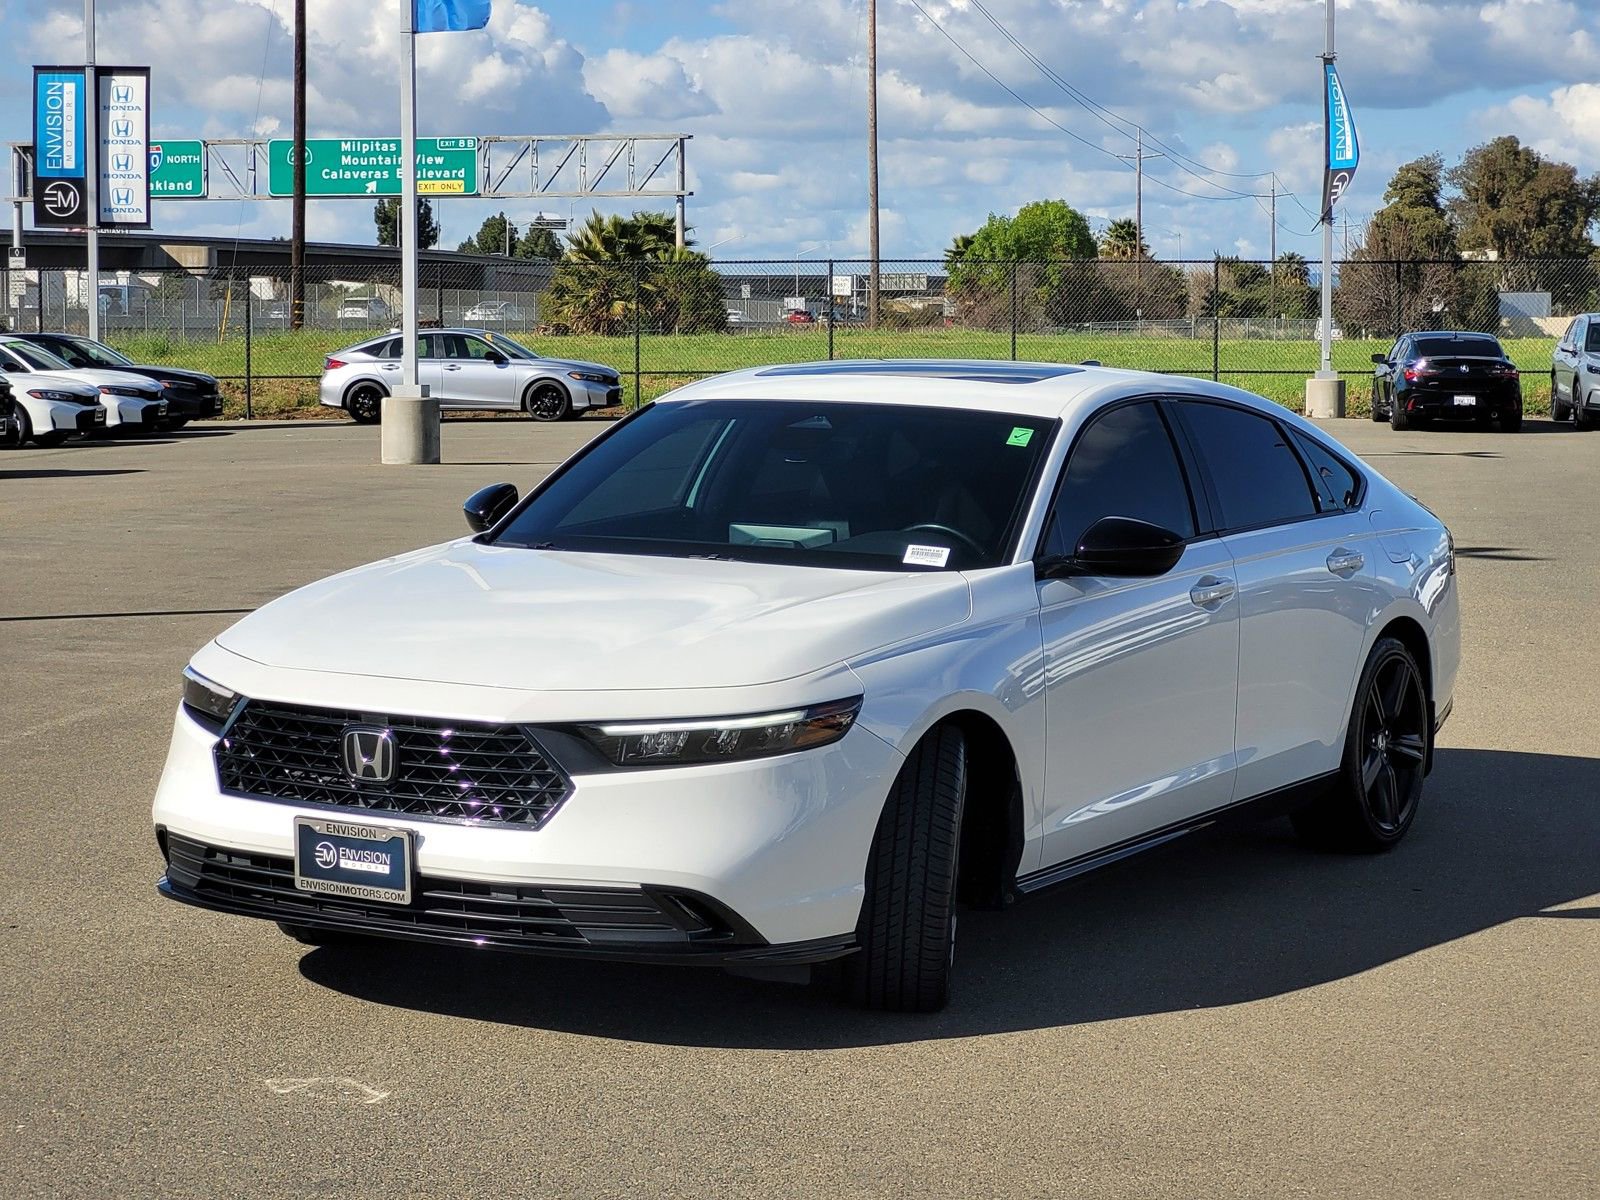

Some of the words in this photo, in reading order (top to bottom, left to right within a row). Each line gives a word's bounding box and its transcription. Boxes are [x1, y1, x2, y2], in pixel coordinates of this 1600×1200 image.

[46, 82, 63, 169] ENVISION
[65, 90, 73, 162] MOTORS
[341, 141, 396, 153] Milpitas
[166, 155, 200, 164] NORTH
[321, 168, 389, 179] Calaveras
[326, 823, 377, 839] ENVISION
[339, 847, 391, 865] ENVISION
[300, 880, 406, 902] ENVISIONMOTORS.COM
